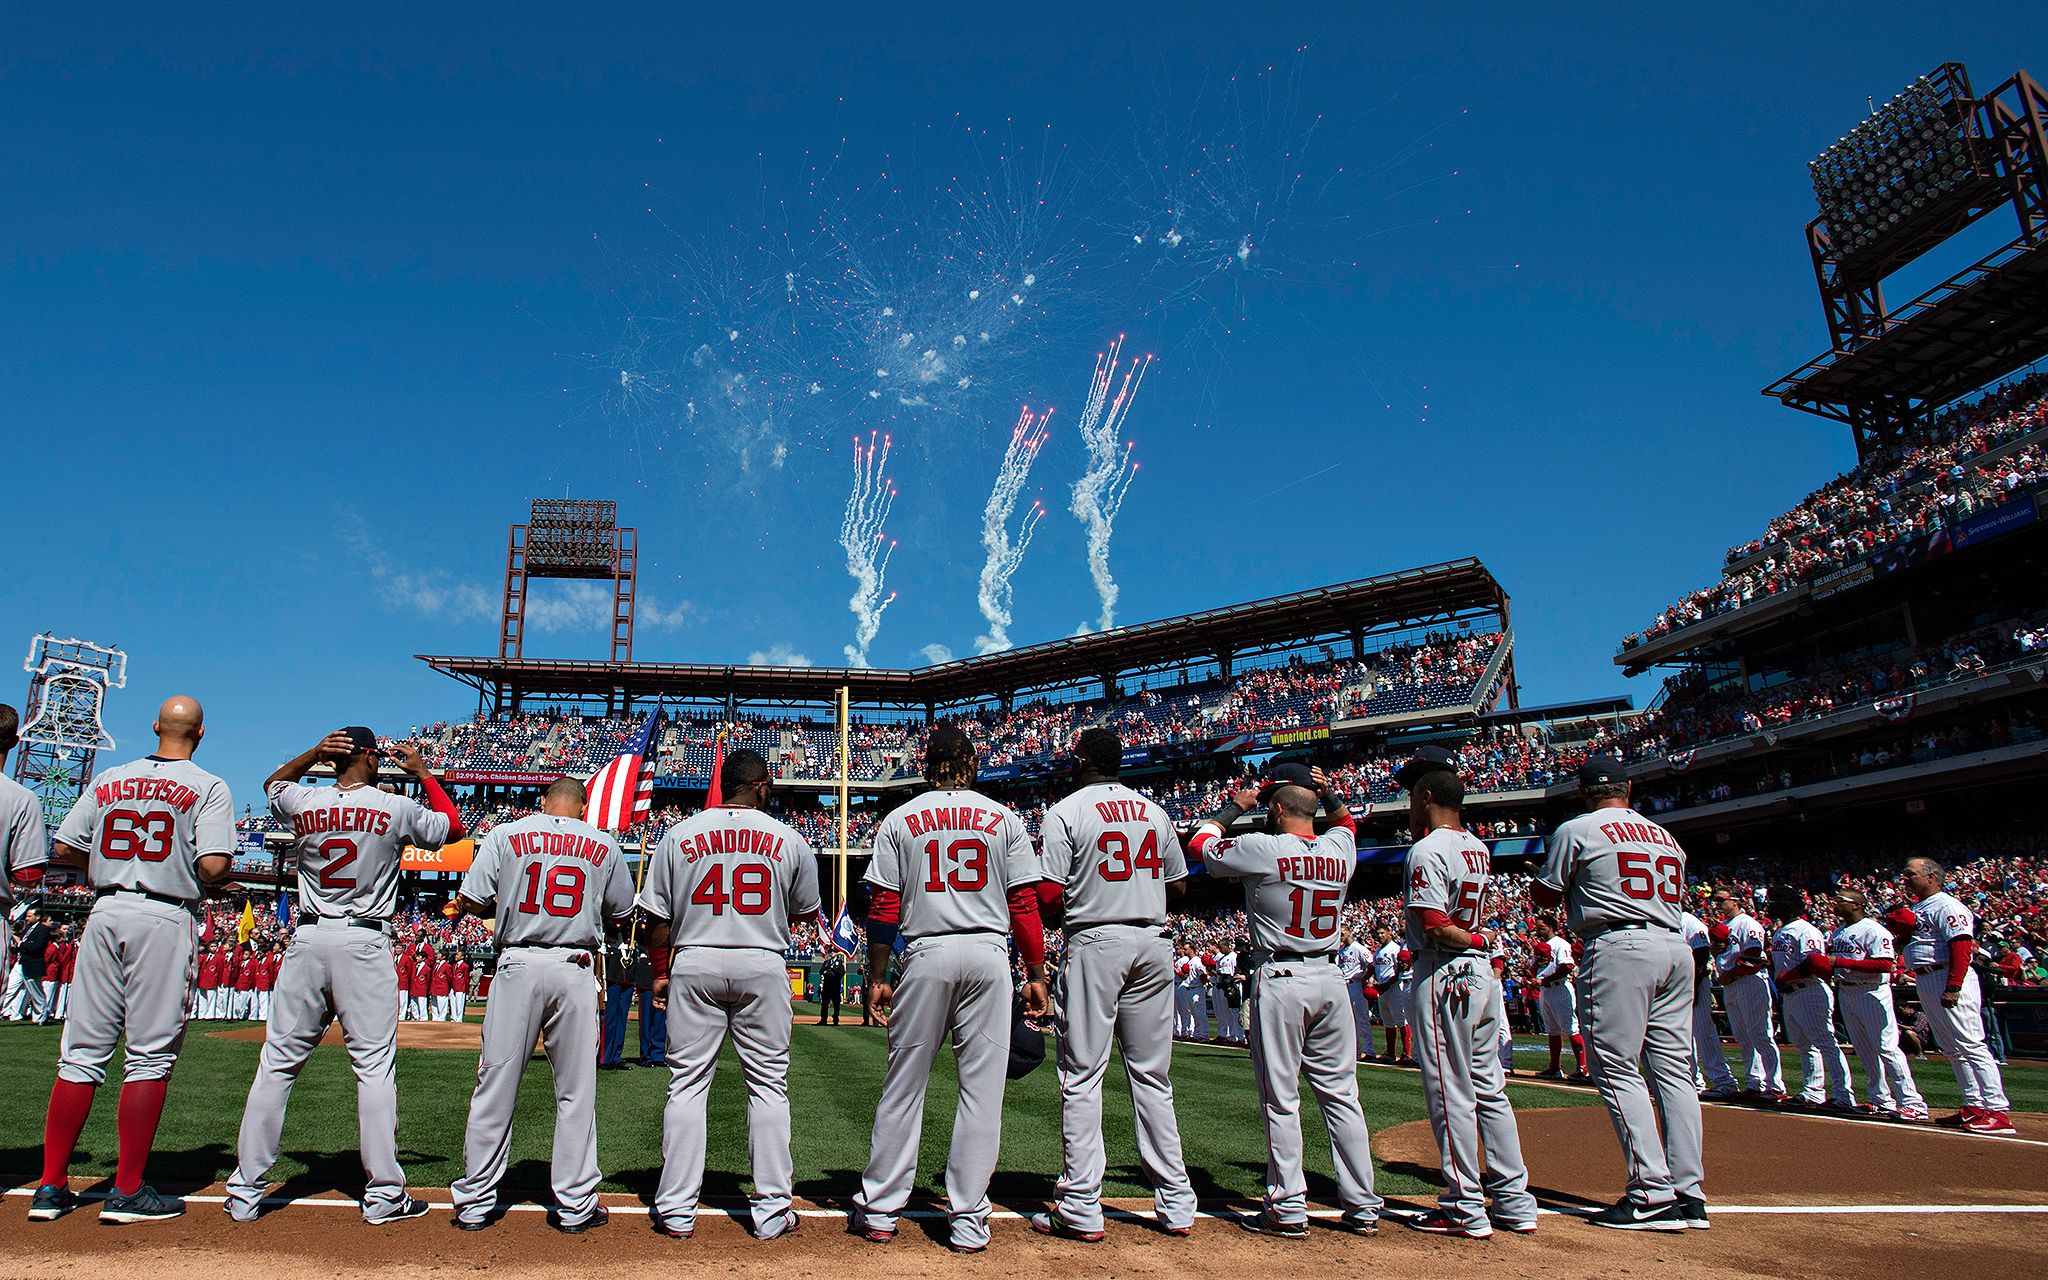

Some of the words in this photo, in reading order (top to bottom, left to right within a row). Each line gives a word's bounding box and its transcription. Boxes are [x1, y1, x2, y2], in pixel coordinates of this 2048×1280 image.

[1813, 572, 1841, 587] BREAKFAST
[1271, 728, 1329, 745] winnerford.com
[96, 777, 200, 815] MASTERSON
[1095, 800, 1150, 823] ORTIZ
[100, 808, 175, 862] 63
[291, 807, 392, 838] BOGAERTS
[904, 807, 1005, 839] RAMIREZ
[319, 838, 357, 889] 2
[508, 831, 609, 867] VICTORINO
[680, 829, 784, 863] SANDOVAL
[1097, 829, 1163, 882] 34
[924, 838, 989, 892] 13
[1276, 856, 1348, 884] PEDROIA
[1616, 852, 1682, 904] 53
[518, 861, 586, 918] 18
[691, 863, 772, 916] 48
[1284, 886, 1342, 939] 15
[1946, 914, 1969, 928] 23
